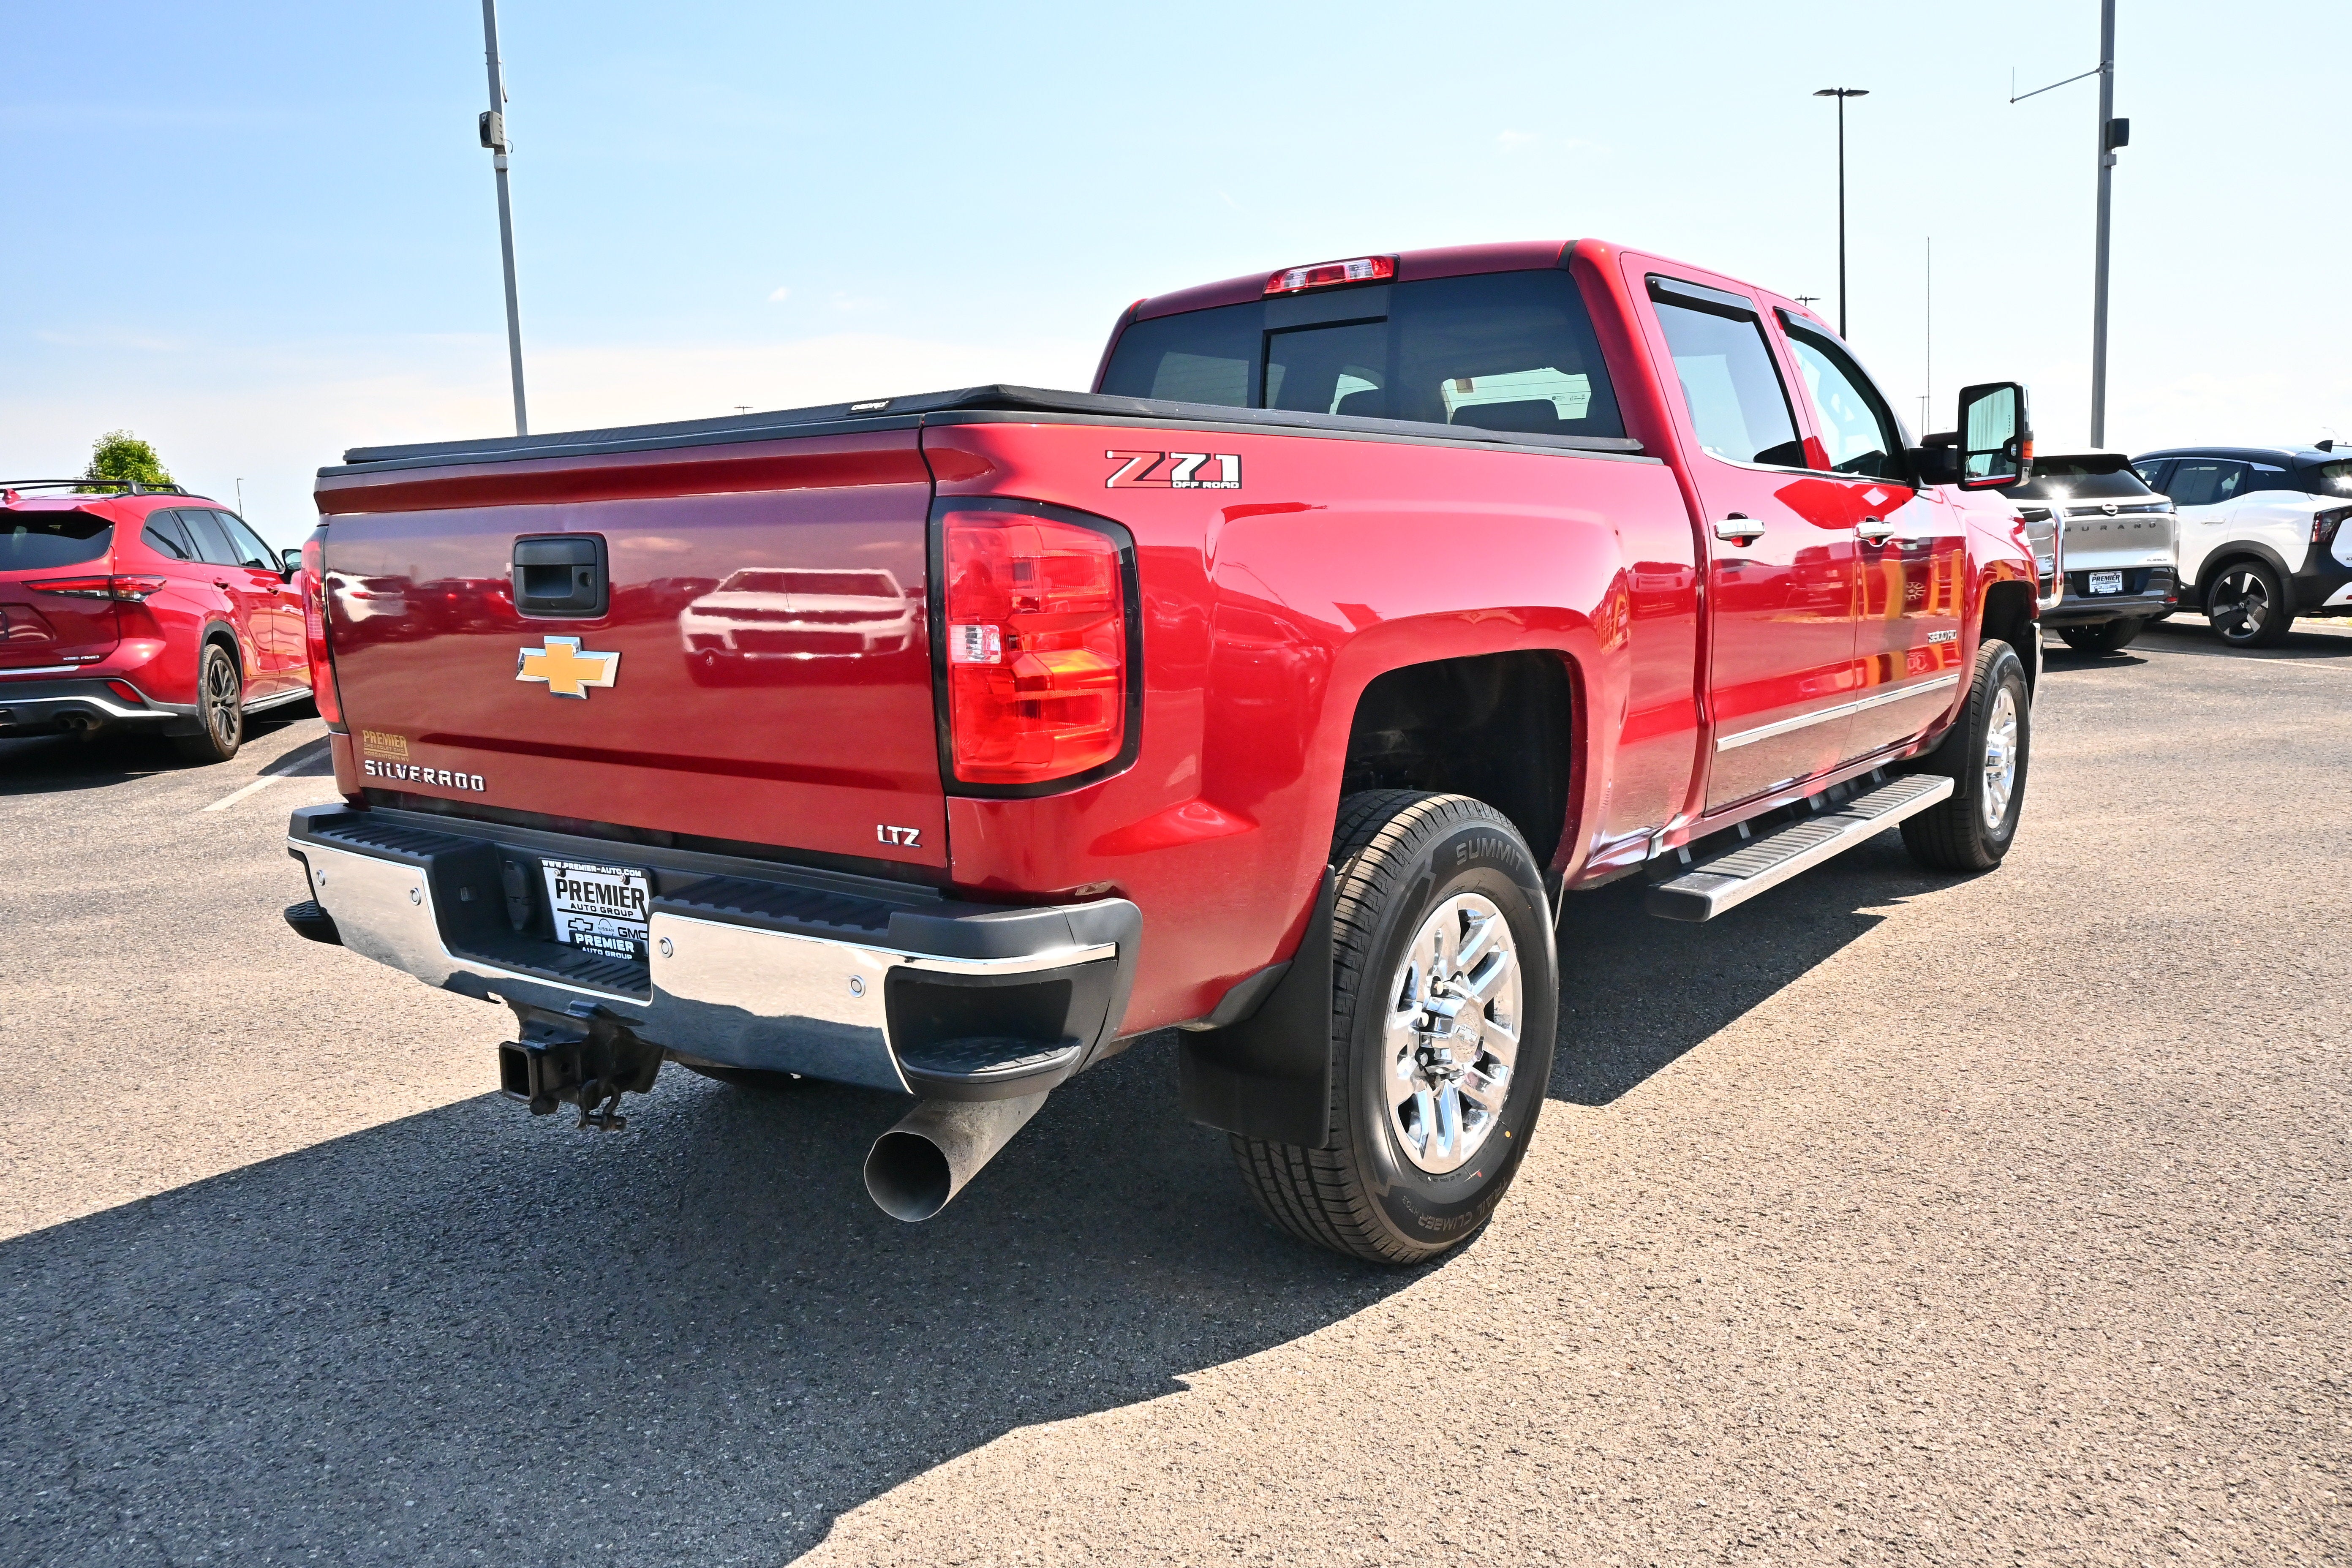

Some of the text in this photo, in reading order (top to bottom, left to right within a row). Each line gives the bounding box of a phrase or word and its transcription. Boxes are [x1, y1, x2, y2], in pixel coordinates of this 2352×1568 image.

[1105, 450, 1242, 489] Z71
[362, 730, 407, 749] PREMIER
[364, 751, 400, 760] MORGANTOWN
[364, 760, 486, 792] SILVERADO
[877, 824, 922, 848] LTZ
[1456, 837, 1524, 871] SUMMIT
[542, 859, 642, 877] WWW.PREMIER-AUTO.COM
[555, 878, 647, 920] PREMIER
[570, 903, 634, 917] AUTO GROUP
[575, 933, 635, 953] PREMIER
[618, 926, 648, 941] GMC
[582, 947, 632, 960] AUTO GROUP
[1418, 1211, 1473, 1231] CLIMBER
